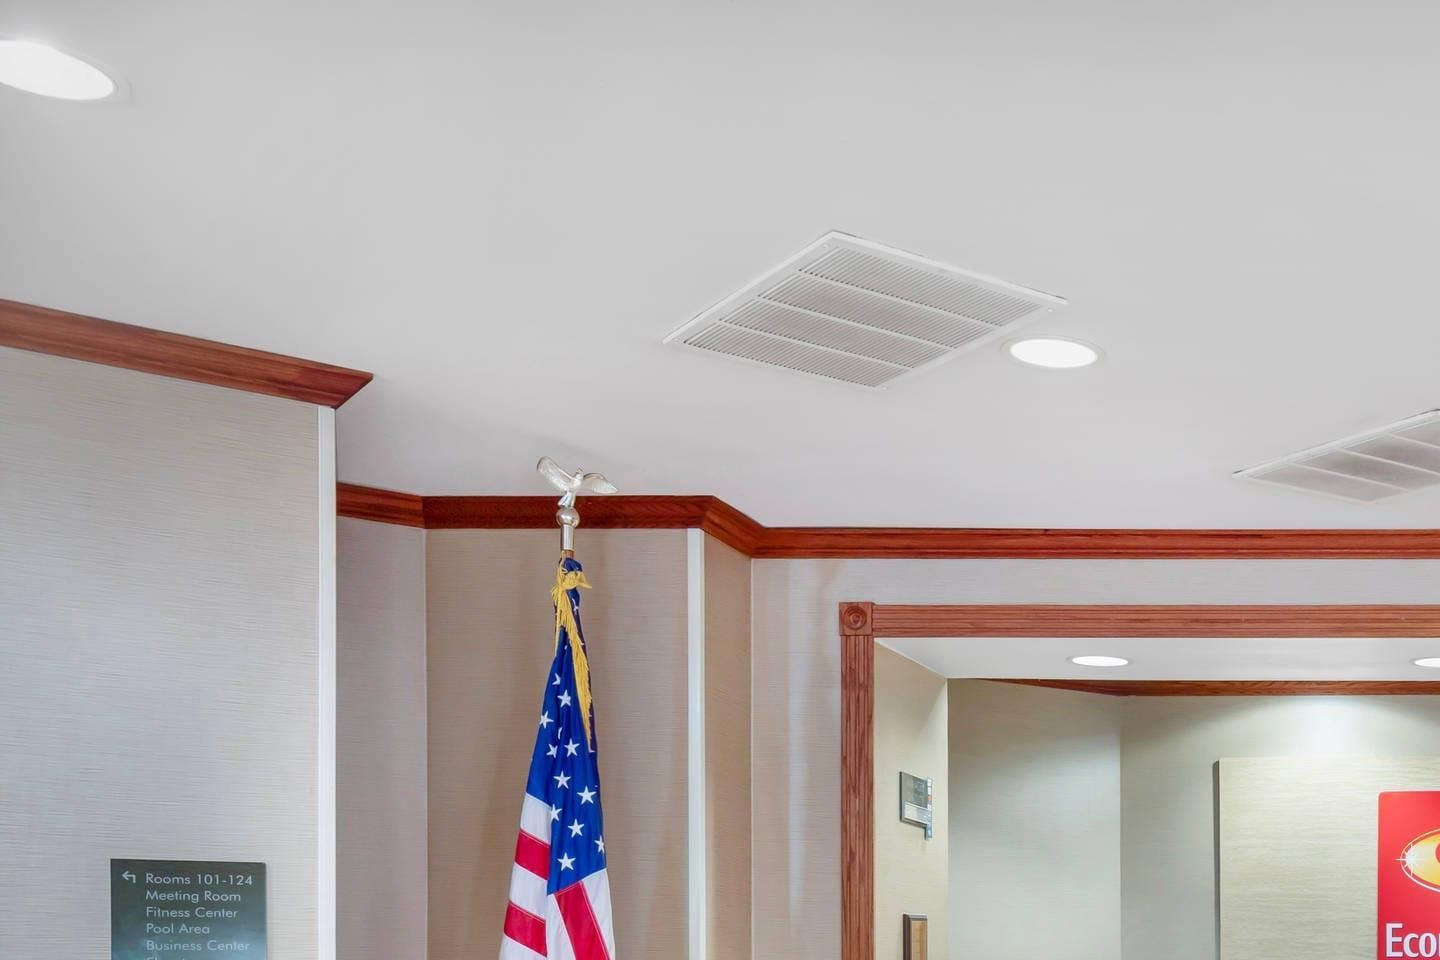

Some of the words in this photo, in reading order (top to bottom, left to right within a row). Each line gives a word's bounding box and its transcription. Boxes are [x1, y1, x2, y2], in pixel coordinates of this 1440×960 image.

[145, 873, 191, 885] Rooms
[197, 874, 253, 886] 101-124
[145, 890, 199, 903] Meeting
[204, 891, 241, 902] Room
[146, 906, 191, 918] Fitness
[195, 907, 238, 918] Center
[146, 923, 174, 934] Pool
[179, 923, 210, 934] Area
[146, 940, 202, 951] Business
[207, 940, 250, 951] Center
